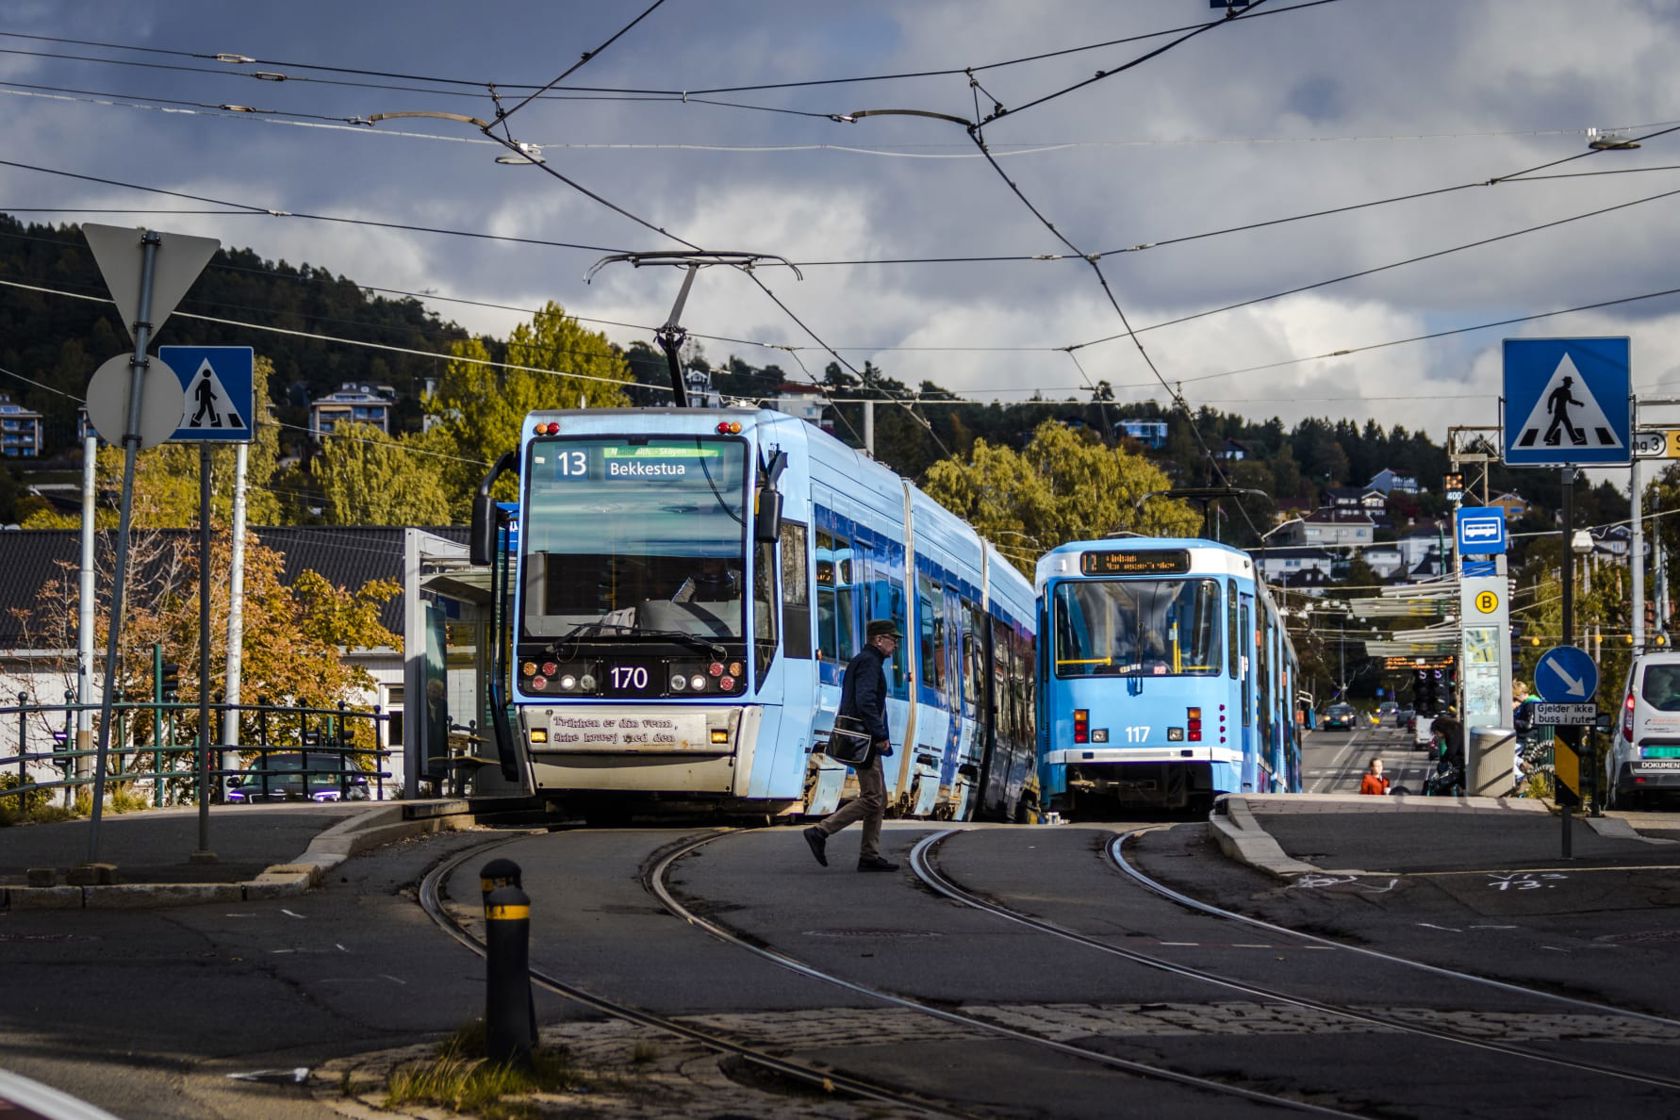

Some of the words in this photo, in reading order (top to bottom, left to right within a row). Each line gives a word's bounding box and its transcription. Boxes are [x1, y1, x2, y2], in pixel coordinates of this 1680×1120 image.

[1651, 436, 1660, 451] 3
[558, 451, 587, 476] 13
[610, 461, 686, 476] Bekkestua
[1482, 595, 1493, 609] B
[611, 667, 648, 689] 170
[1537, 704, 1570, 714] Gjelder
[1574, 704, 1594, 713] ikke
[552, 716, 600, 729] Trikken
[603, 718, 615, 729] er
[618, 717, 639, 729] din
[1538, 714, 1560, 723] buss
[553, 731, 579, 743] ikke
[622, 732, 648, 744] med
[653, 733, 676, 743] den
[1125, 726, 1151, 743] 117
[1641, 761, 1680, 769] DOKUMEN
